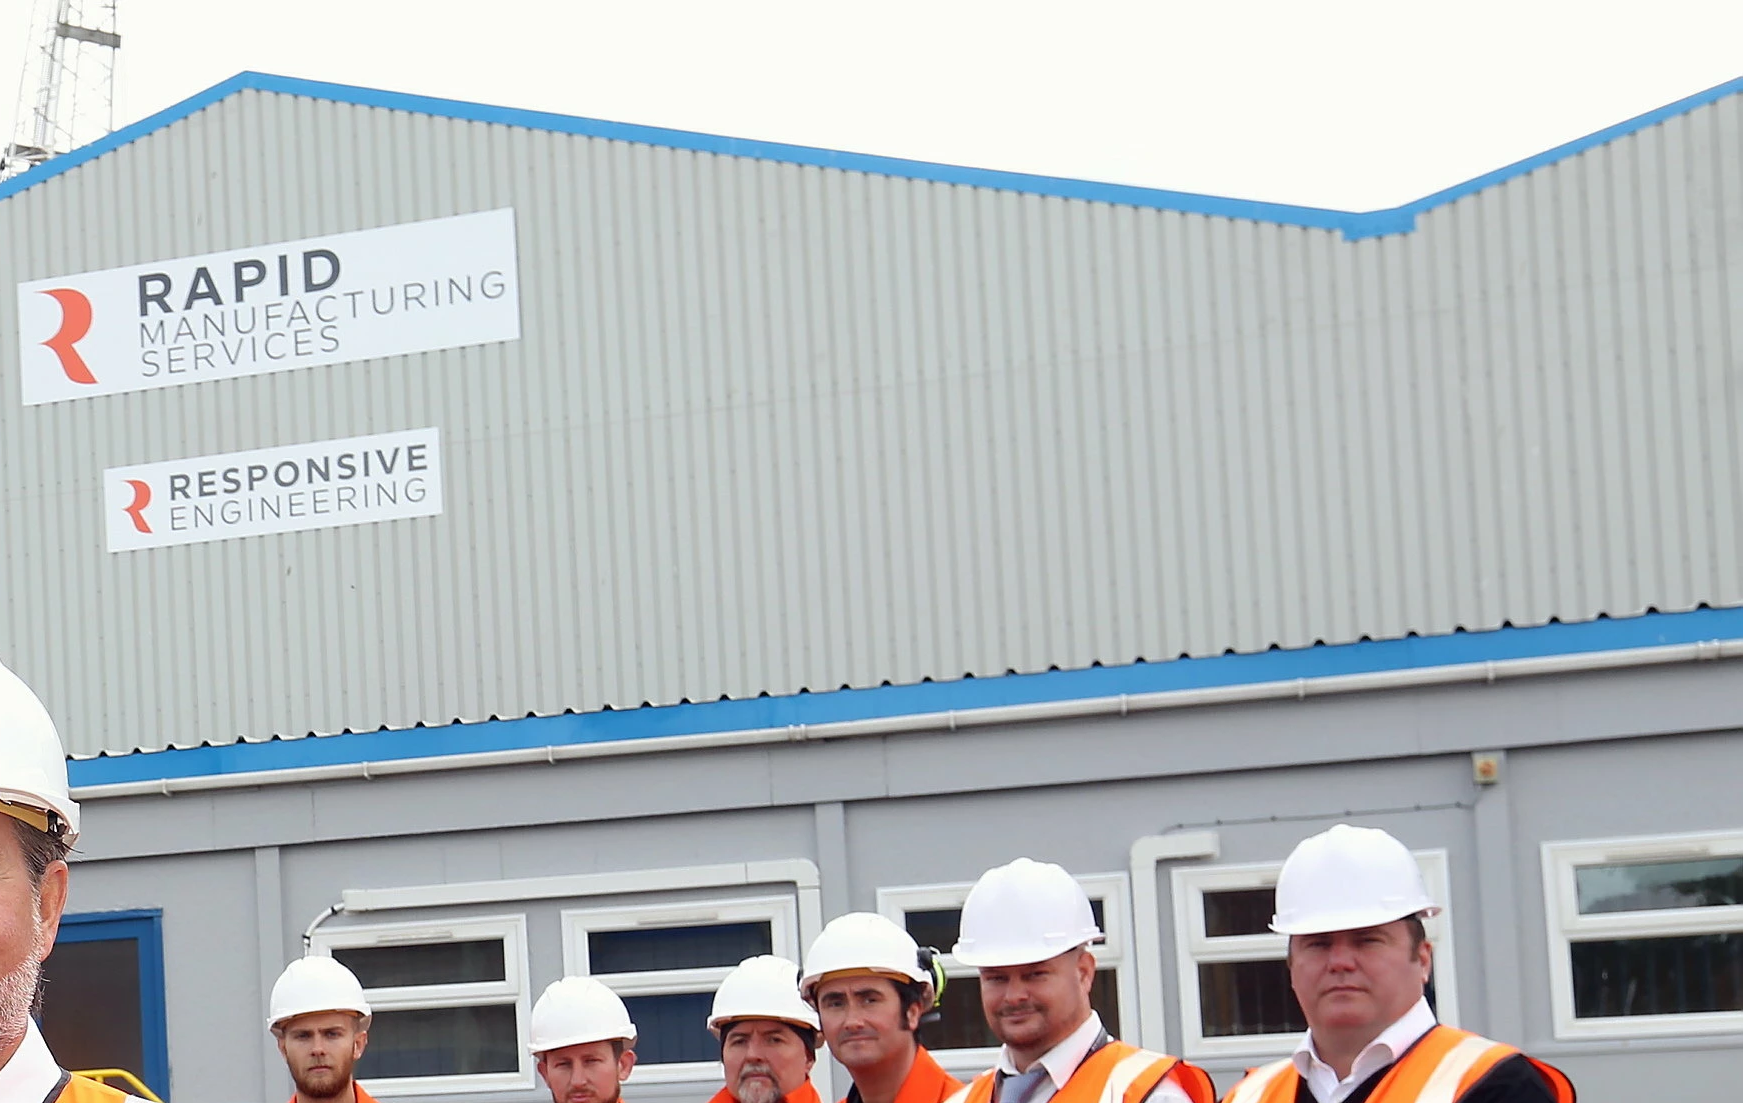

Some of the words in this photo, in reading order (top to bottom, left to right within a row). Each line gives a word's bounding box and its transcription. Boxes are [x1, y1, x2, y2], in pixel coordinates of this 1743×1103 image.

[137, 248, 340, 316] RAPID
[140, 270, 505, 348] MANUFACTURING
[141, 325, 340, 378] SERVICES
[169, 444, 428, 501] RESPONSIVE
[170, 477, 426, 531] ENGINEERING
